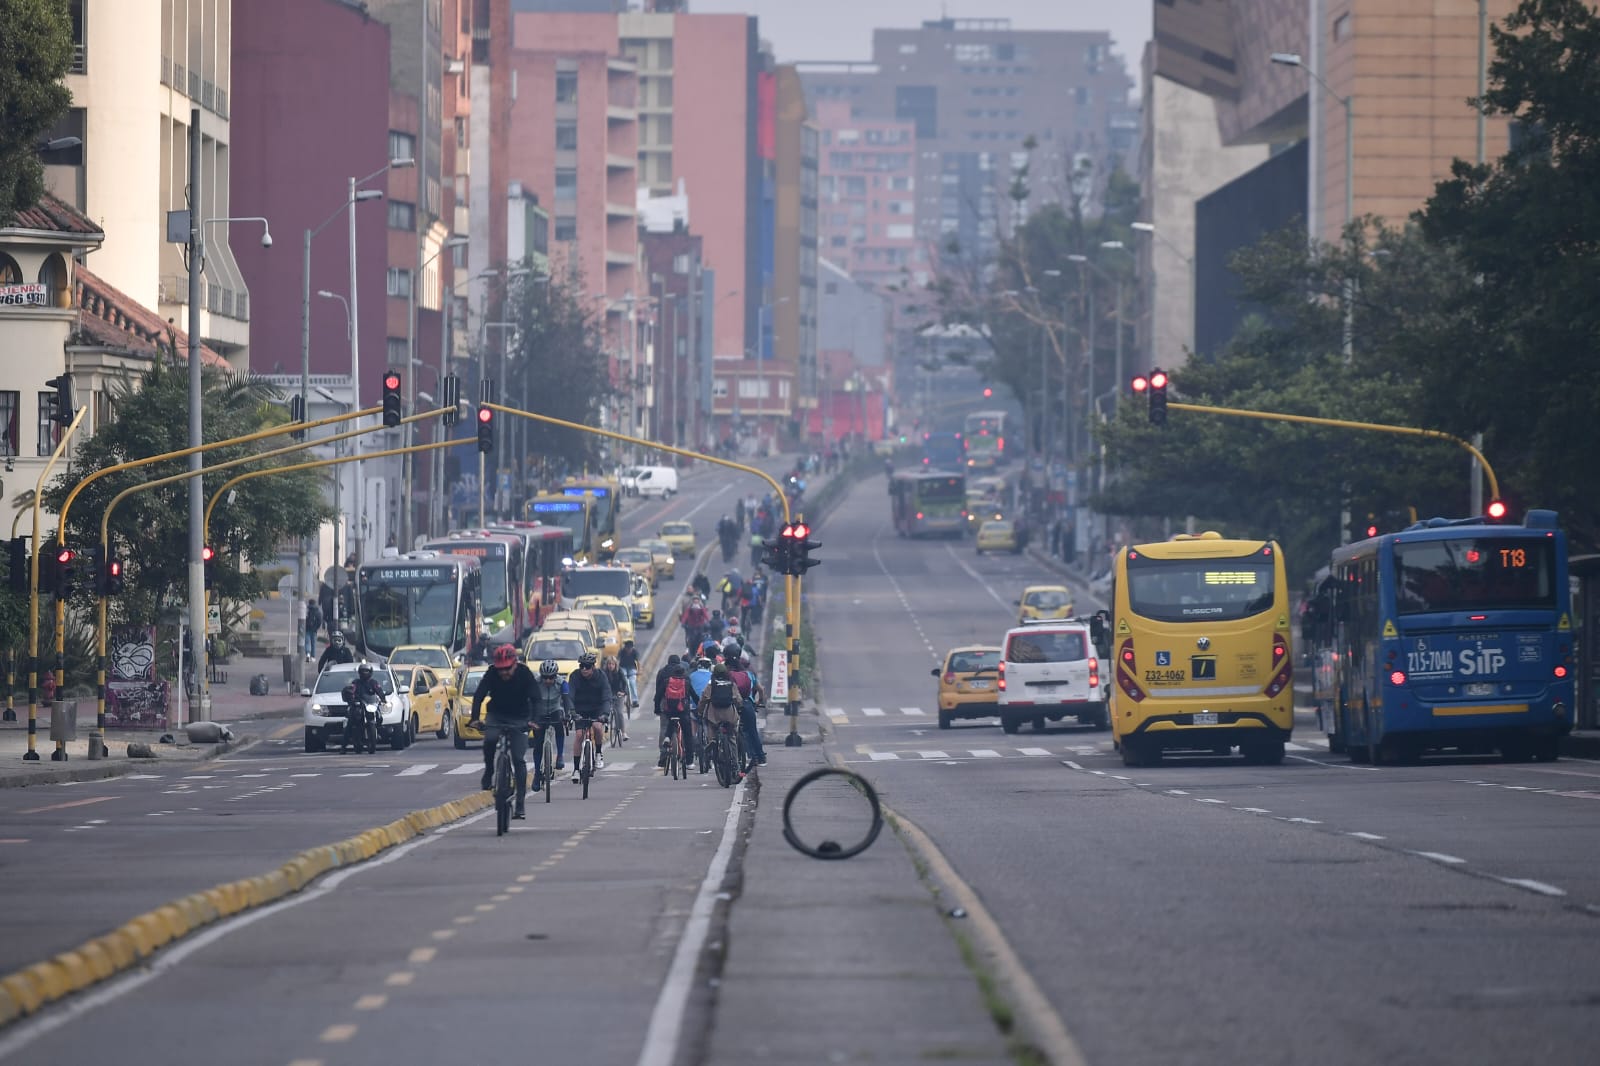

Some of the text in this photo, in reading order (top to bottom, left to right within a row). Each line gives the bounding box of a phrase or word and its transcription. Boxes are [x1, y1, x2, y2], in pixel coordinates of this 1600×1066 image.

[1500, 549, 1525, 567] T13
[411, 569, 419, 577] DE
[421, 568, 439, 577] JULIO
[1407, 650, 1453, 672] Z15-7040
[776, 653, 786, 695] TALLER
[1145, 670, 1185, 681] Z32-4062
